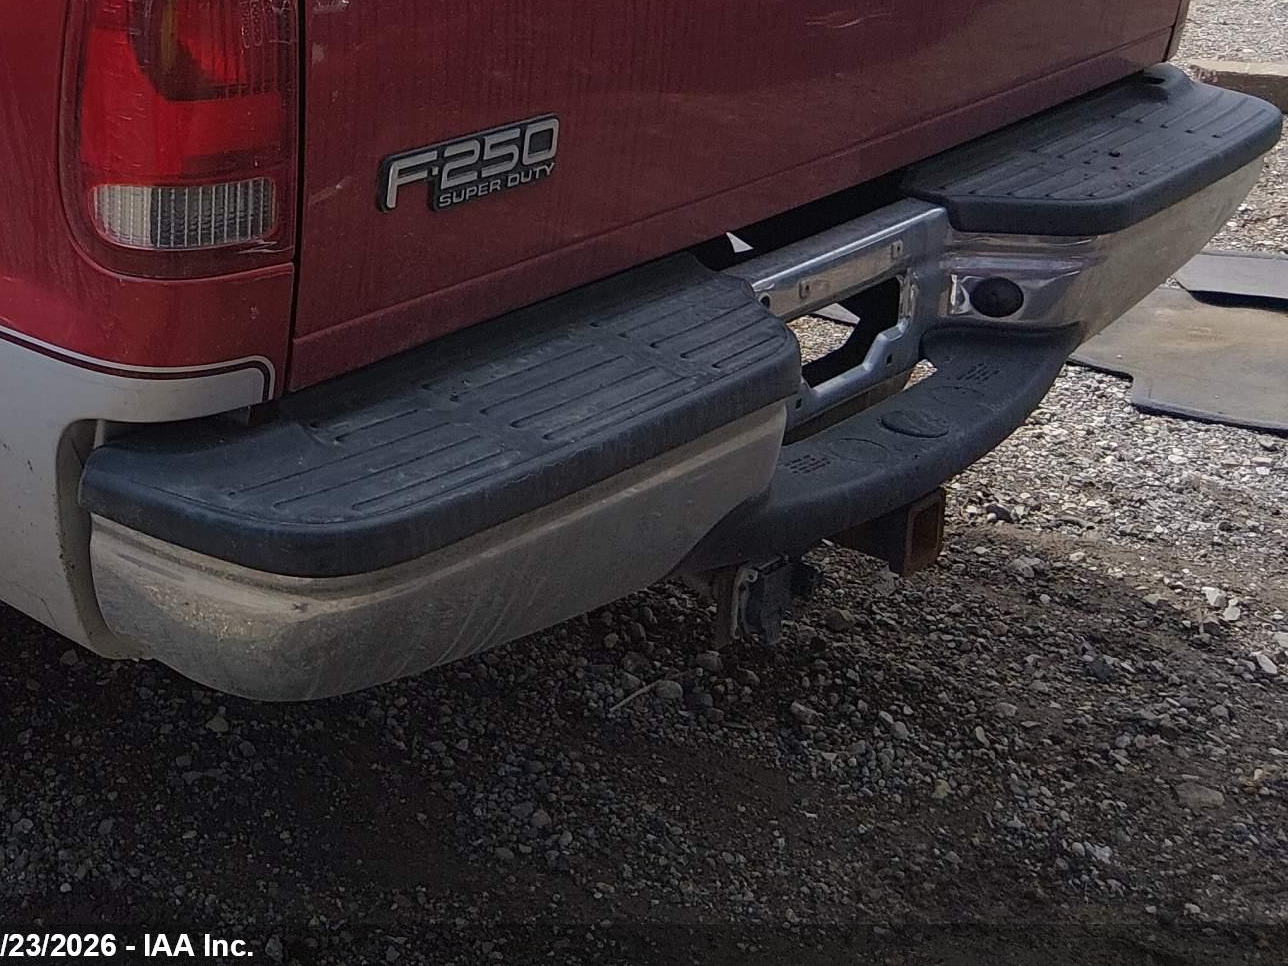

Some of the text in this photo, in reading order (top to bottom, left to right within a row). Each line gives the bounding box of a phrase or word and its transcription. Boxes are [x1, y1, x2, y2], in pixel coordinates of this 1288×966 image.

[386, 118, 560, 209] F-250
[438, 161, 556, 207] SUPER DUTY
